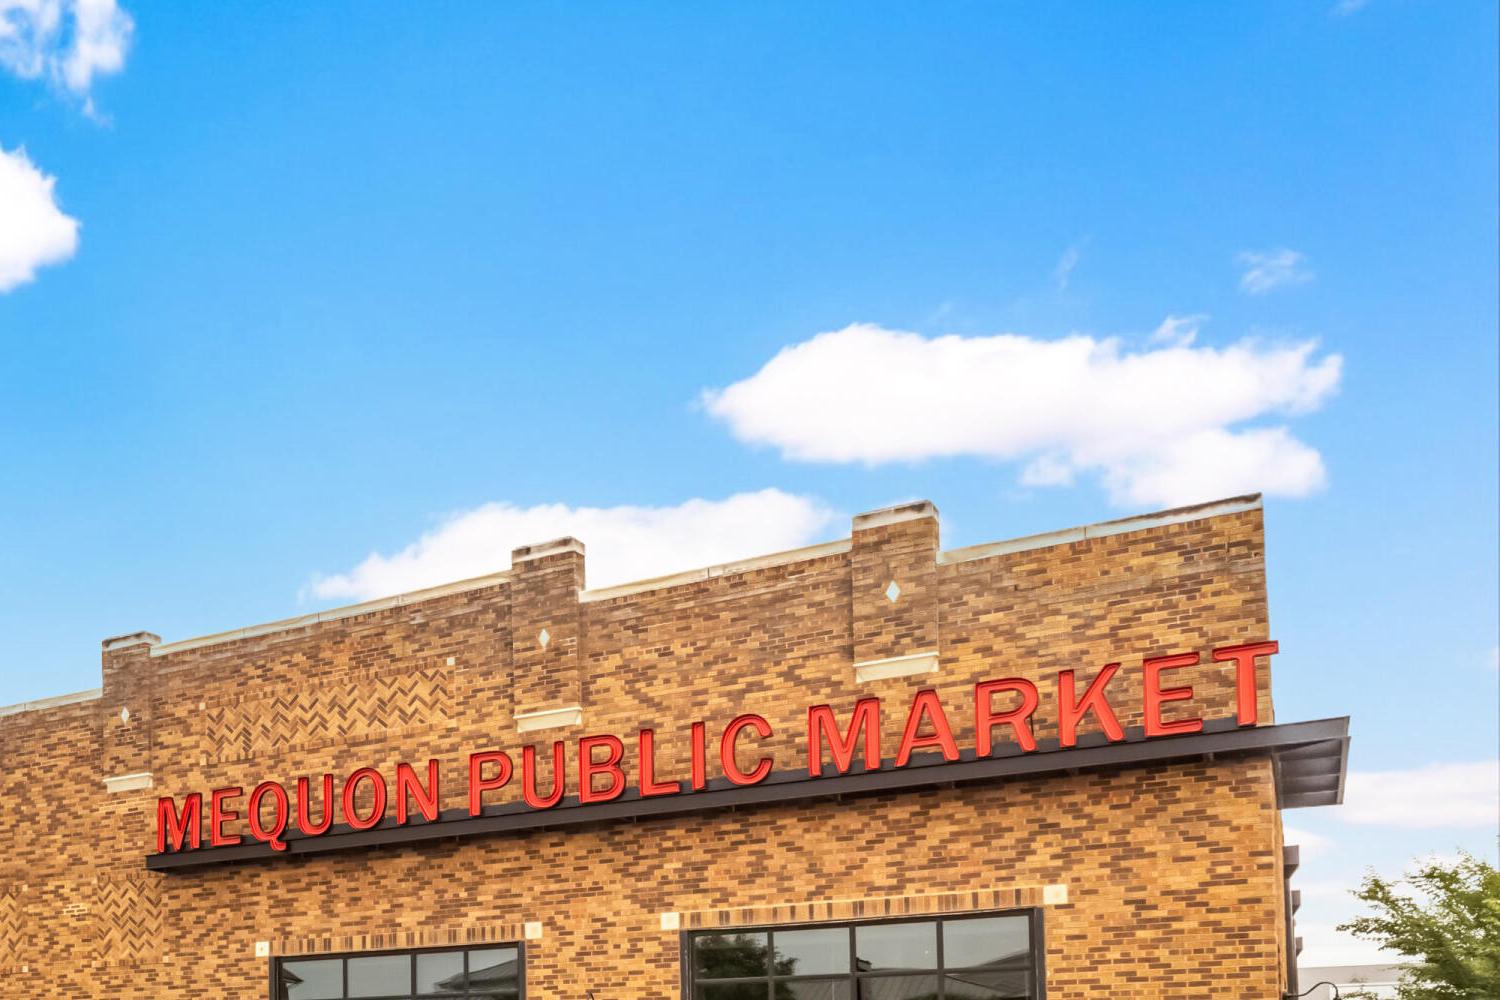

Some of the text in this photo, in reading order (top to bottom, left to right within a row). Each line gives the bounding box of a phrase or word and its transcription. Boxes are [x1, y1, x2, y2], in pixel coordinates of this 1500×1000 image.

[155, 640, 1280, 854] MEQUON PUBLIC MARKET
